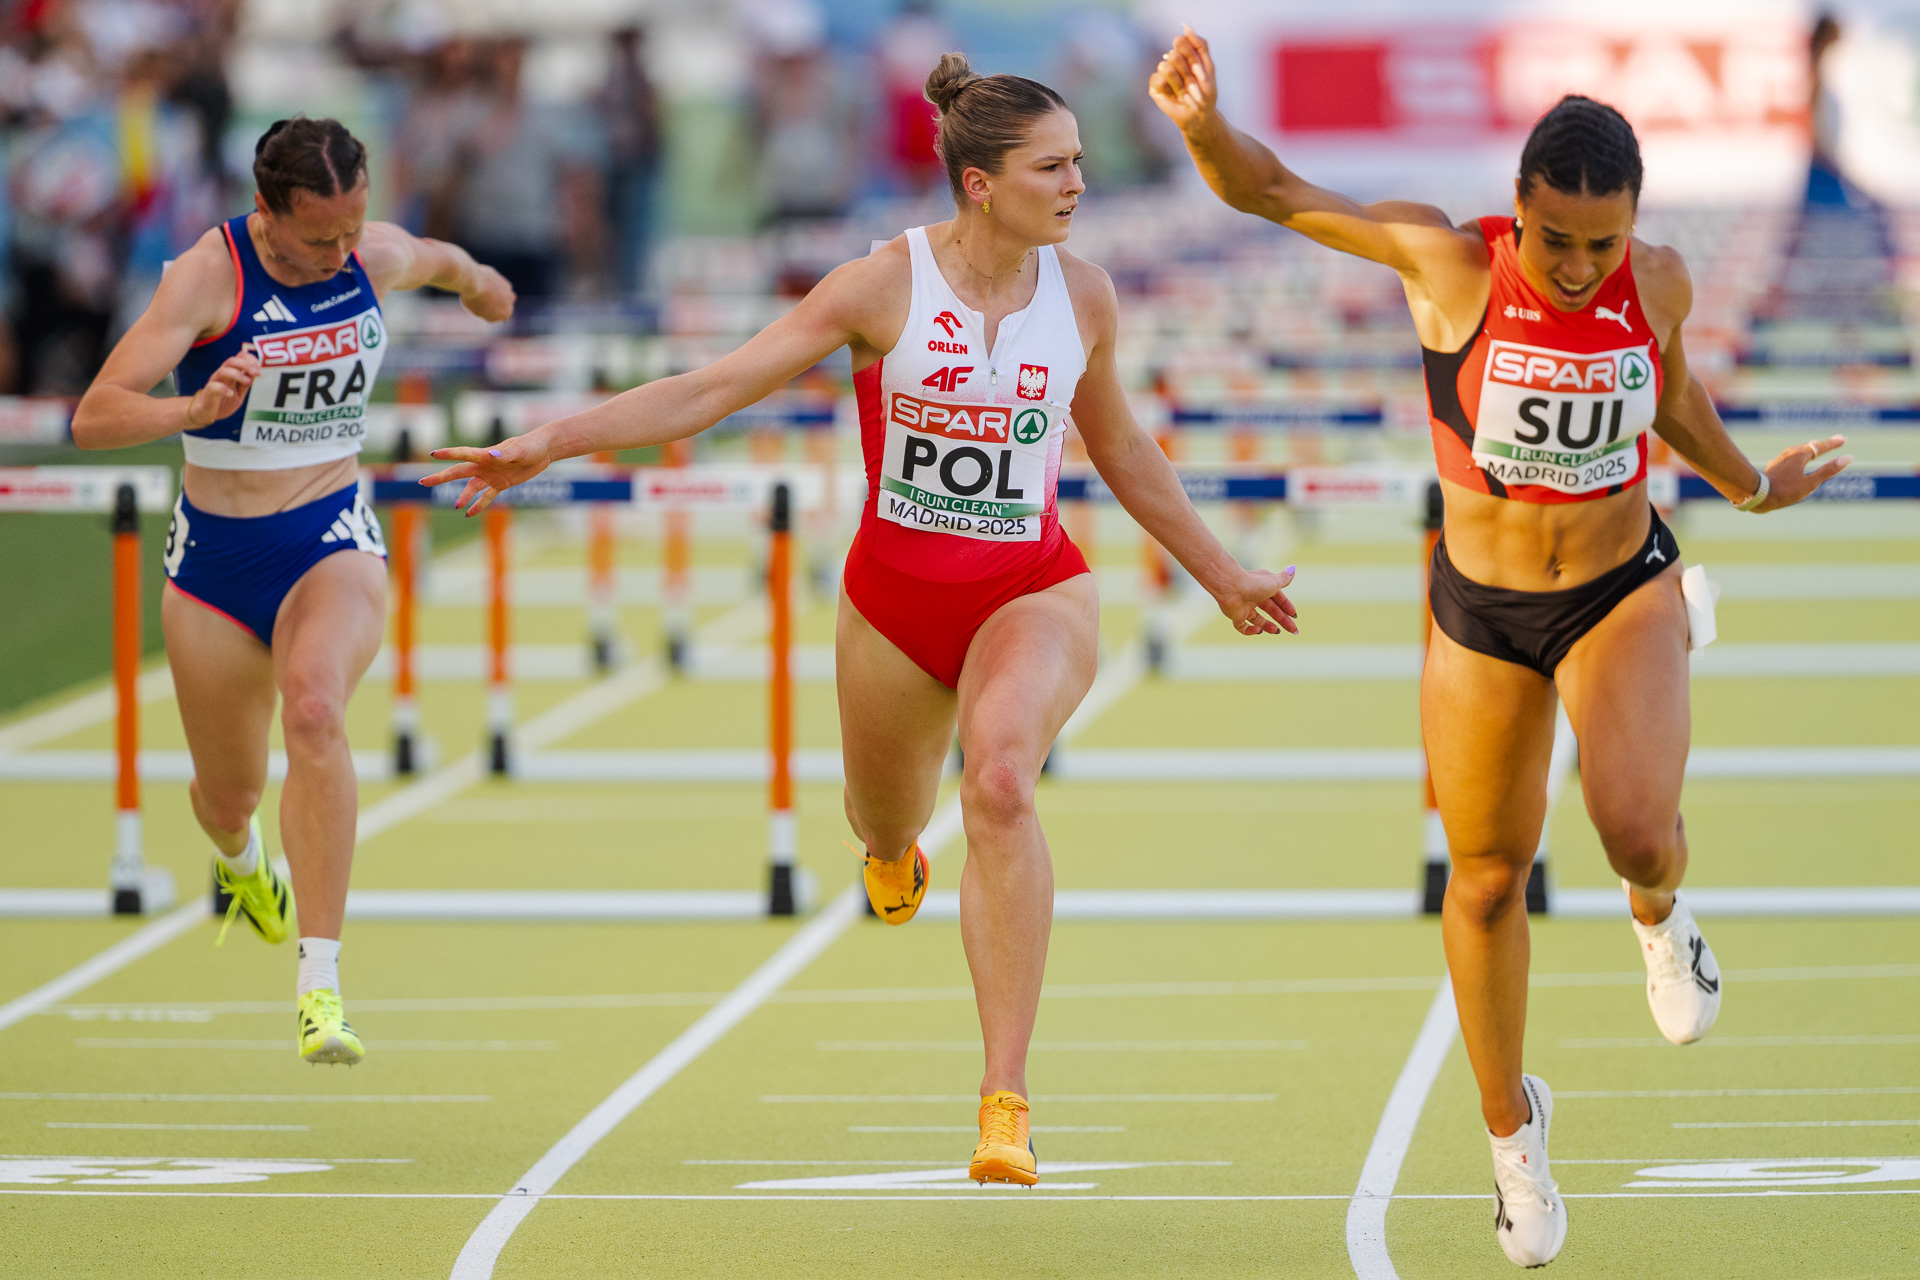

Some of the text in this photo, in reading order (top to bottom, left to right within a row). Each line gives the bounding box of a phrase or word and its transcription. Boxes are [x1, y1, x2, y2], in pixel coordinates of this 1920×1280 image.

[1518, 307, 1541, 321] UBS
[262, 325, 357, 365] SPAR
[928, 340, 968, 355] ORLEN
[273, 359, 366, 410] FRA
[922, 366, 974, 392] 4F
[1492, 352, 1615, 390] SPAR
[285, 412, 316, 424] RUN
[317, 406, 360, 420] CLEAN
[894, 397, 1006, 438] SPAR
[1514, 397, 1624, 449] SUI
[255, 426, 333, 443] MADRID
[901, 434, 1024, 499] POL
[1487, 456, 1627, 487] MADRID 2025
[1520, 448, 1556, 464] RUN
[909, 487, 915, 500] I
[916, 490, 949, 509] RUN
[889, 498, 1027, 535] MADRID 2025
